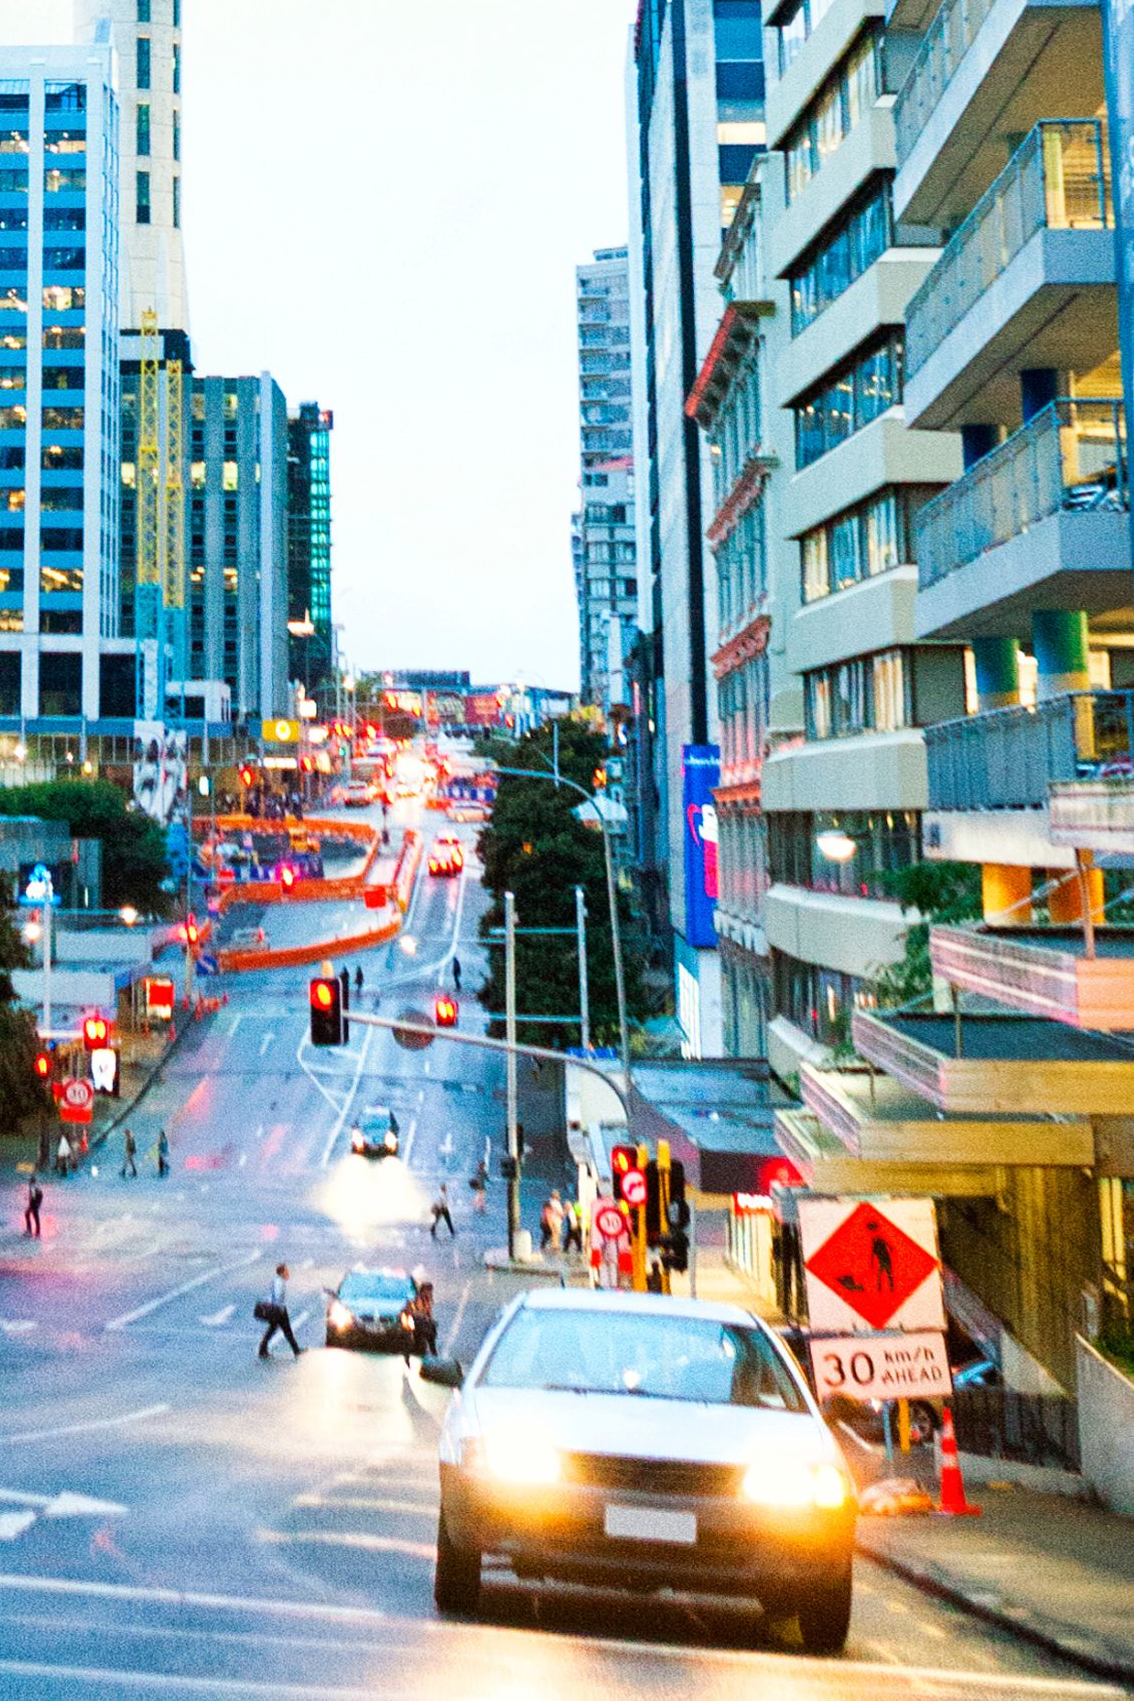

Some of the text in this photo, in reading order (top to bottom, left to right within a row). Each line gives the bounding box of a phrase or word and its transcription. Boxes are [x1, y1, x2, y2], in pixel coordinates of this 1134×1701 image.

[823, 1345, 935, 1388] 30 km/h
[881, 1365, 943, 1385] AHEAD
